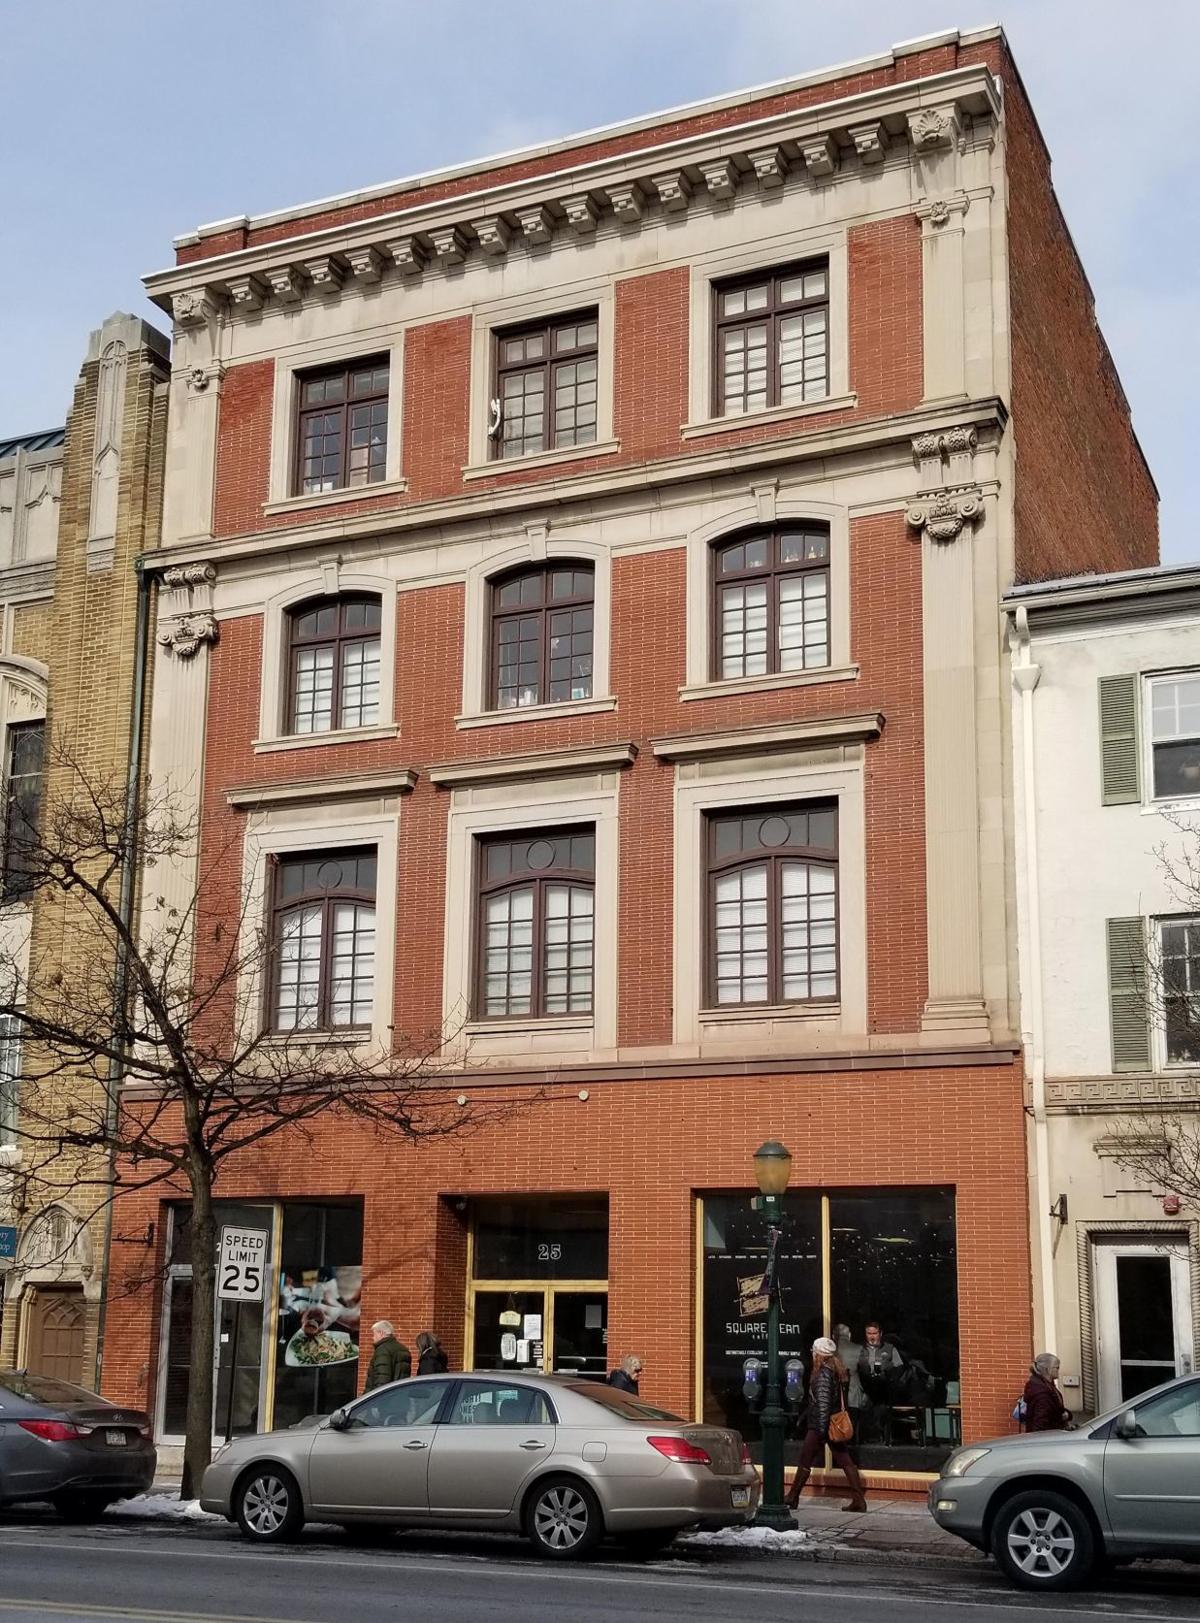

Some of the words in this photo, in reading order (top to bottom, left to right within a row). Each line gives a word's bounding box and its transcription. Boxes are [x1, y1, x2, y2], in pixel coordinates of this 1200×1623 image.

[225, 1235, 264, 1249] SPEED
[228, 1249, 258, 1263] LIMIT
[538, 1244, 561, 1260] 25
[222, 1264, 260, 1293] 25
[725, 1322, 767, 1334] SQUARE
[777, 1323, 800, 1334] EAN
